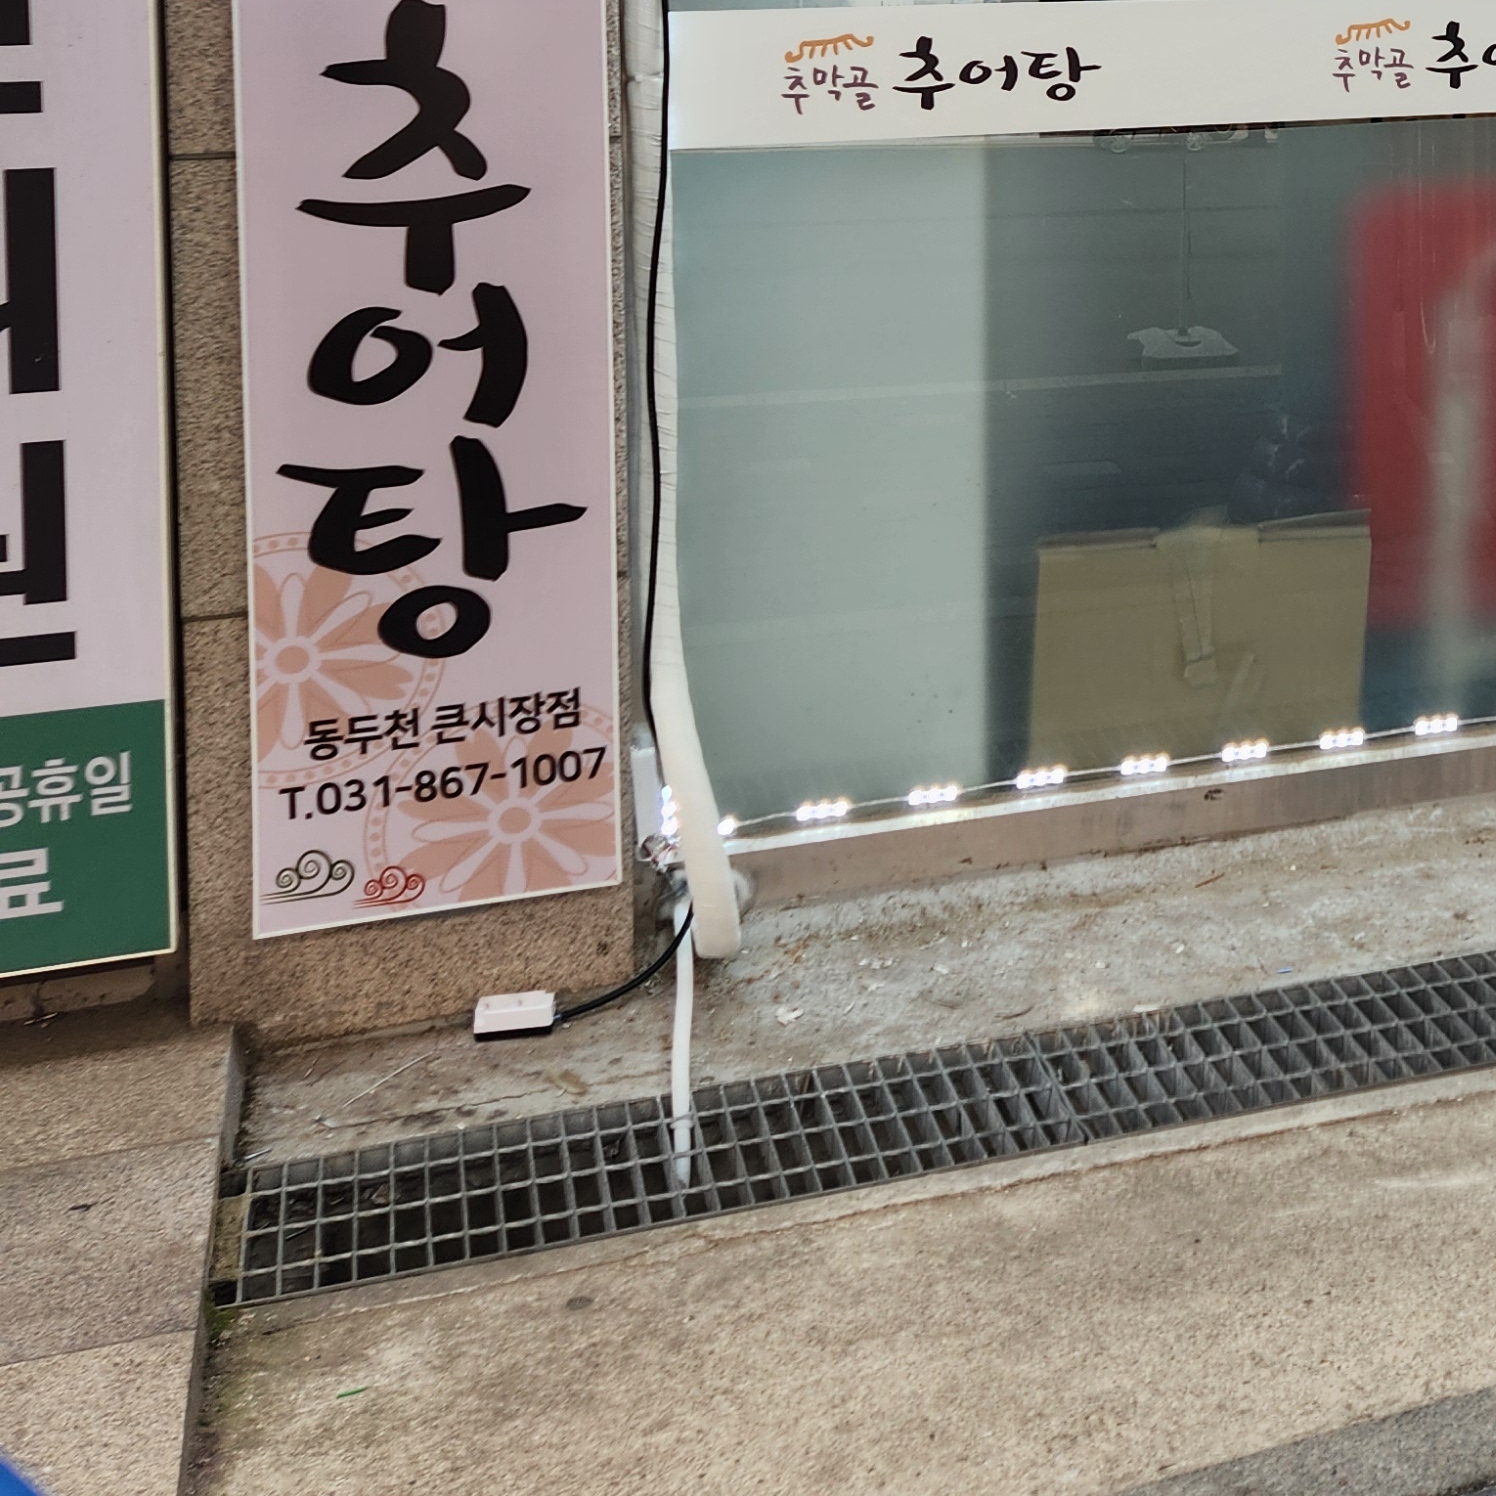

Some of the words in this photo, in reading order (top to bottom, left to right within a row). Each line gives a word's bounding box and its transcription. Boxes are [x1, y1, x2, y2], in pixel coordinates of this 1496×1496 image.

[781, 66, 878, 114] 추막골
[893, 36, 1102, 110] 추어탕
[1332, 47, 1414, 91] 추막골
[305, 709, 420, 761] 동두천
[431, 687, 582, 744] 큰시장점
[279, 746, 608, 820] T.031-867-1007
